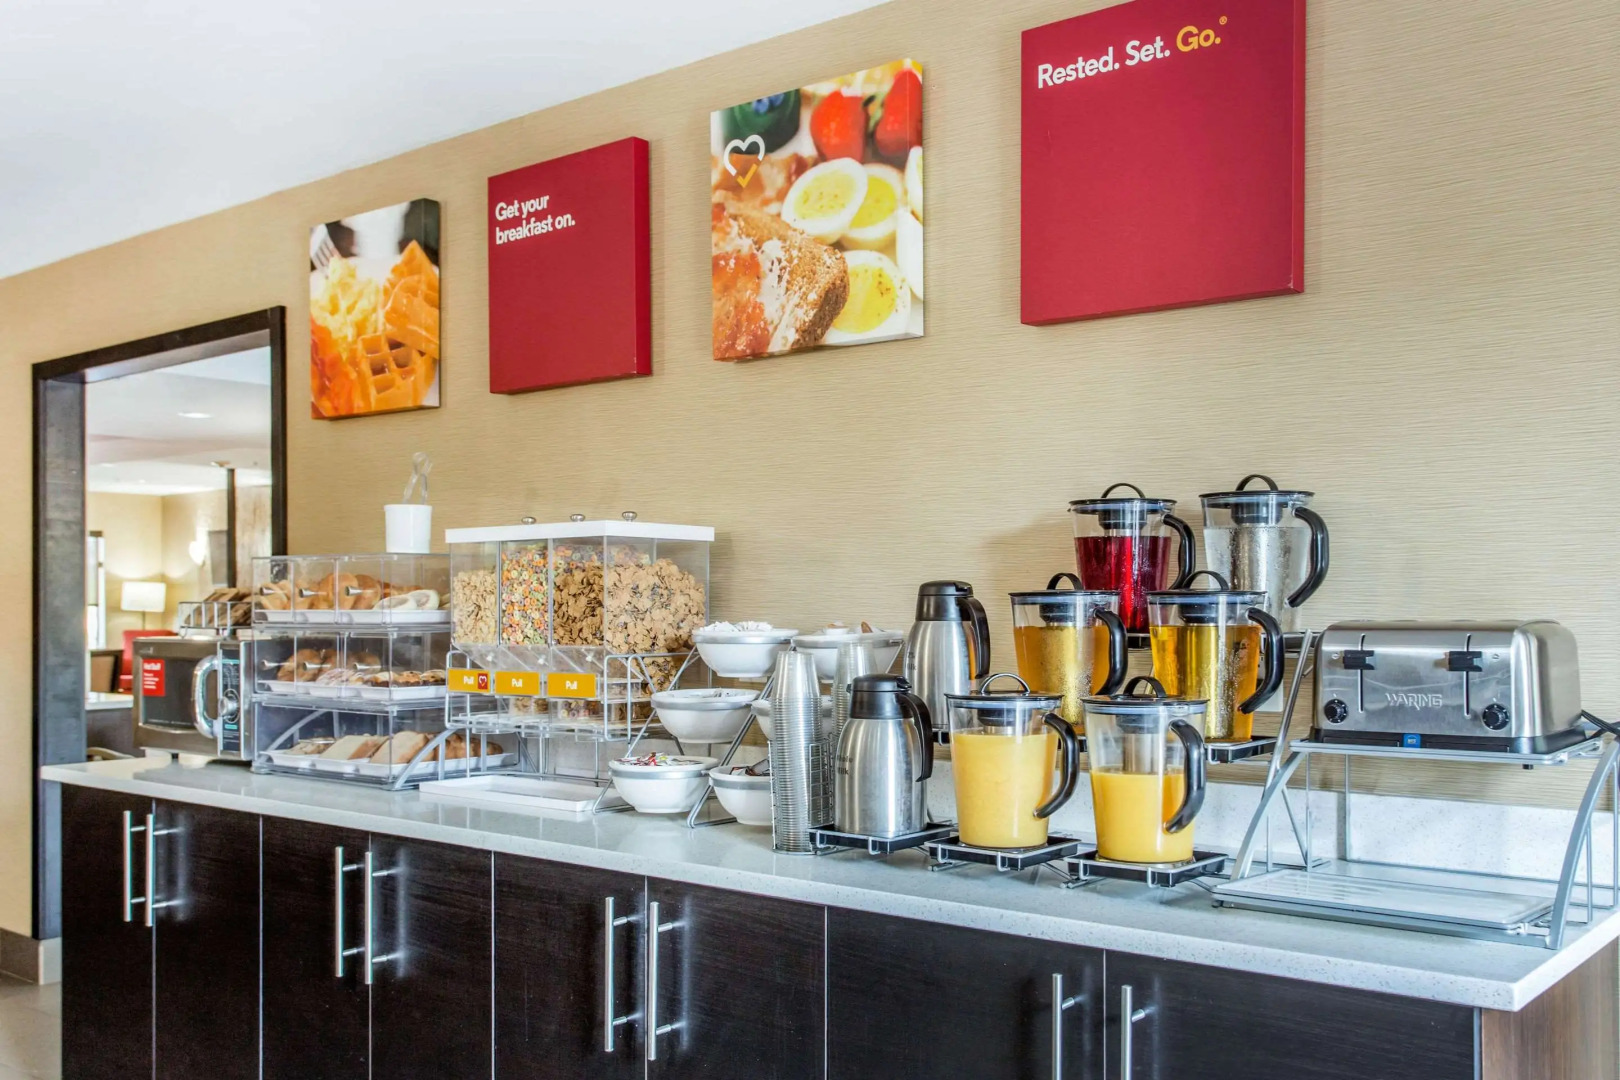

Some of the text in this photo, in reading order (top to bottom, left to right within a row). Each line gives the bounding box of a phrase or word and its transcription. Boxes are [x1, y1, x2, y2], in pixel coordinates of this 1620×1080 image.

[1037, 46, 1120, 89] Rested.
[1125, 35, 1170, 66] Set.
[495, 194, 550, 221] Get your
[495, 213, 576, 245] breakfast on.
[511, 678, 523, 688] Pull
[565, 680, 578, 690] Pull
[1385, 692, 1443, 711] WARING
